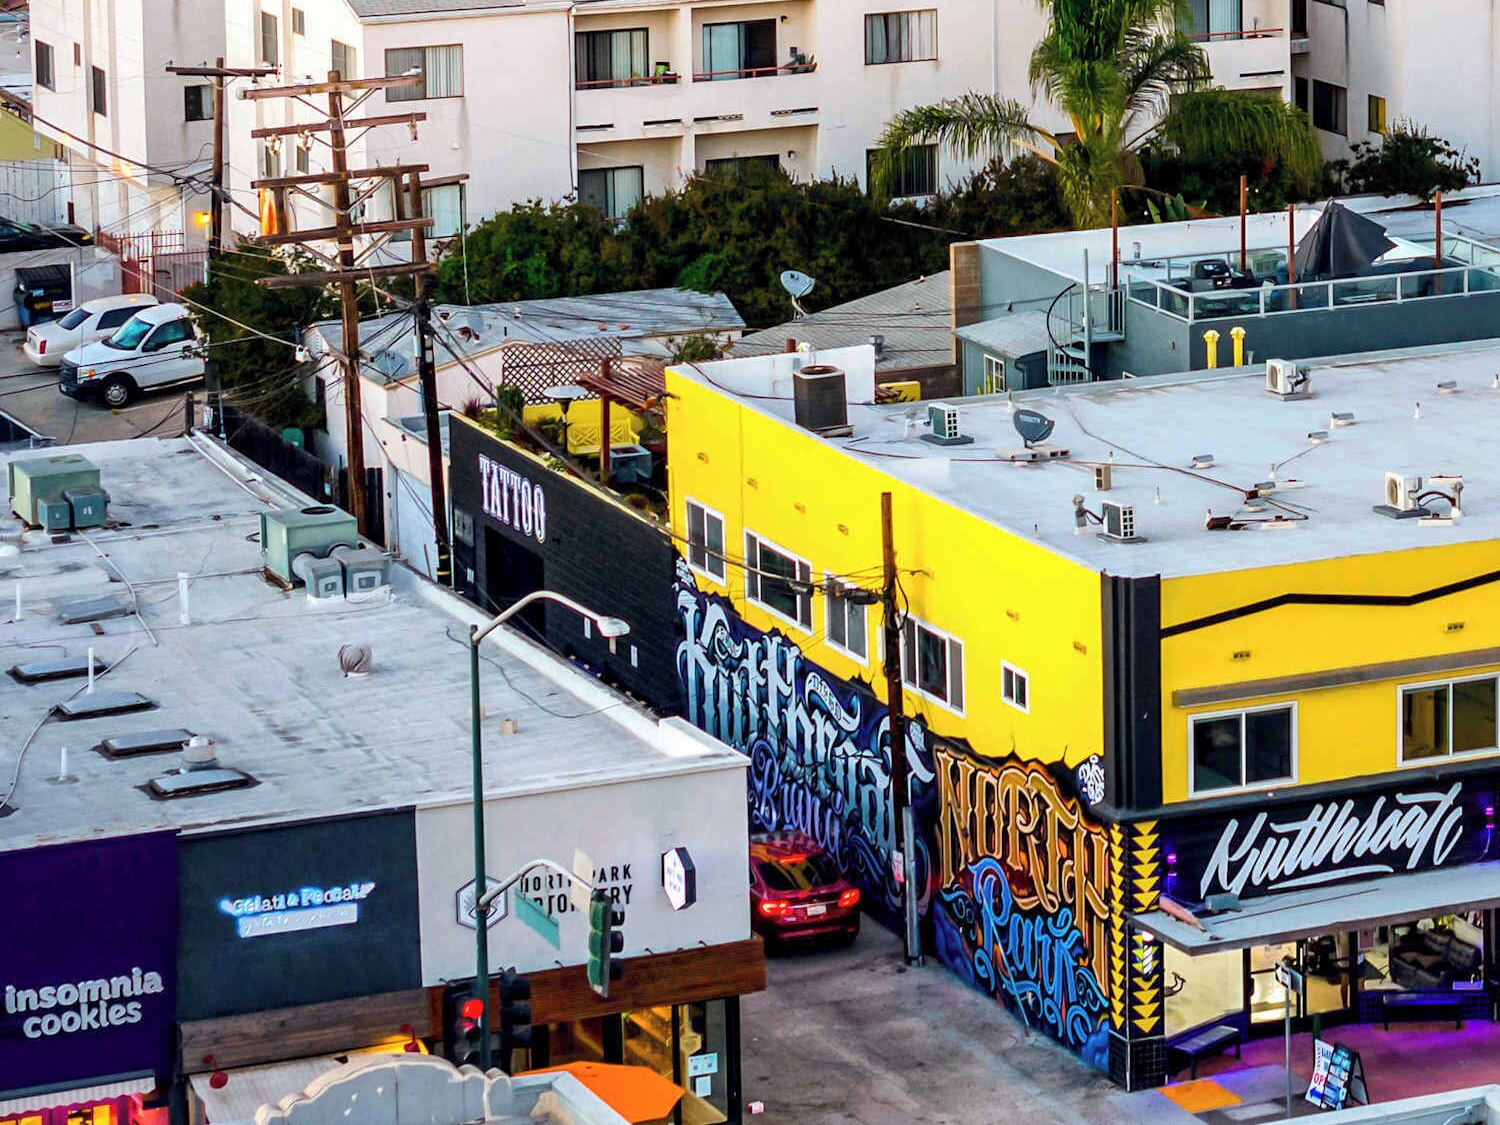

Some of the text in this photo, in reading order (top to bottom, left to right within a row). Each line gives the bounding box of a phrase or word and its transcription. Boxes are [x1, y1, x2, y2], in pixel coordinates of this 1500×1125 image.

[479, 453, 546, 544] TATTOO
[937, 749, 1109, 997] NORTH
[5, 967, 164, 1014] insomnia
[23, 1000, 142, 1039] cookies
